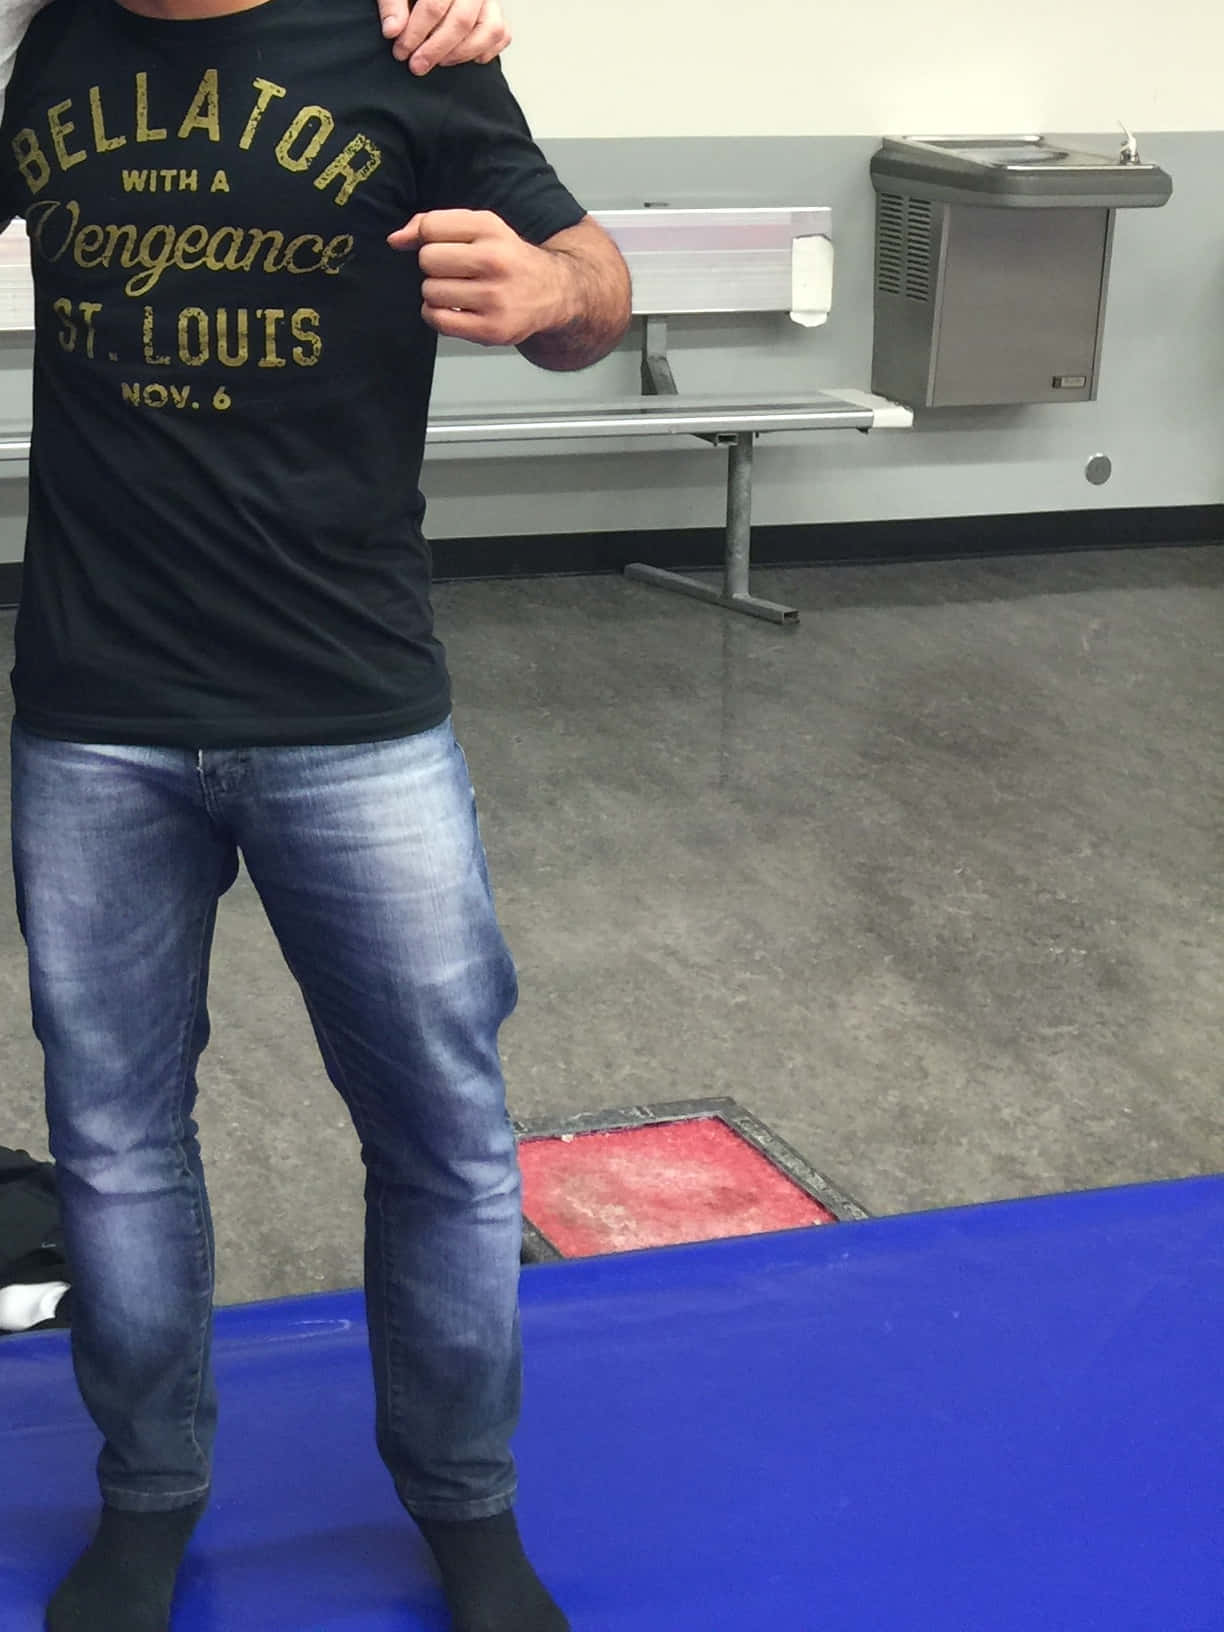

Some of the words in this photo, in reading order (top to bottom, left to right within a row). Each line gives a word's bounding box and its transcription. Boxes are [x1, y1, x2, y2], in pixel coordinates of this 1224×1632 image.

[10, 67, 384, 207] BELLATOR
[121, 168, 199, 193] WITH
[210, 169, 231, 193] A
[23, 199, 356, 298] Vengeance
[52, 297, 119, 363] ST.
[142, 305, 323, 369] LOUIS
[120, 382, 201, 411] NOV.
[212, 385, 233, 411] 6
